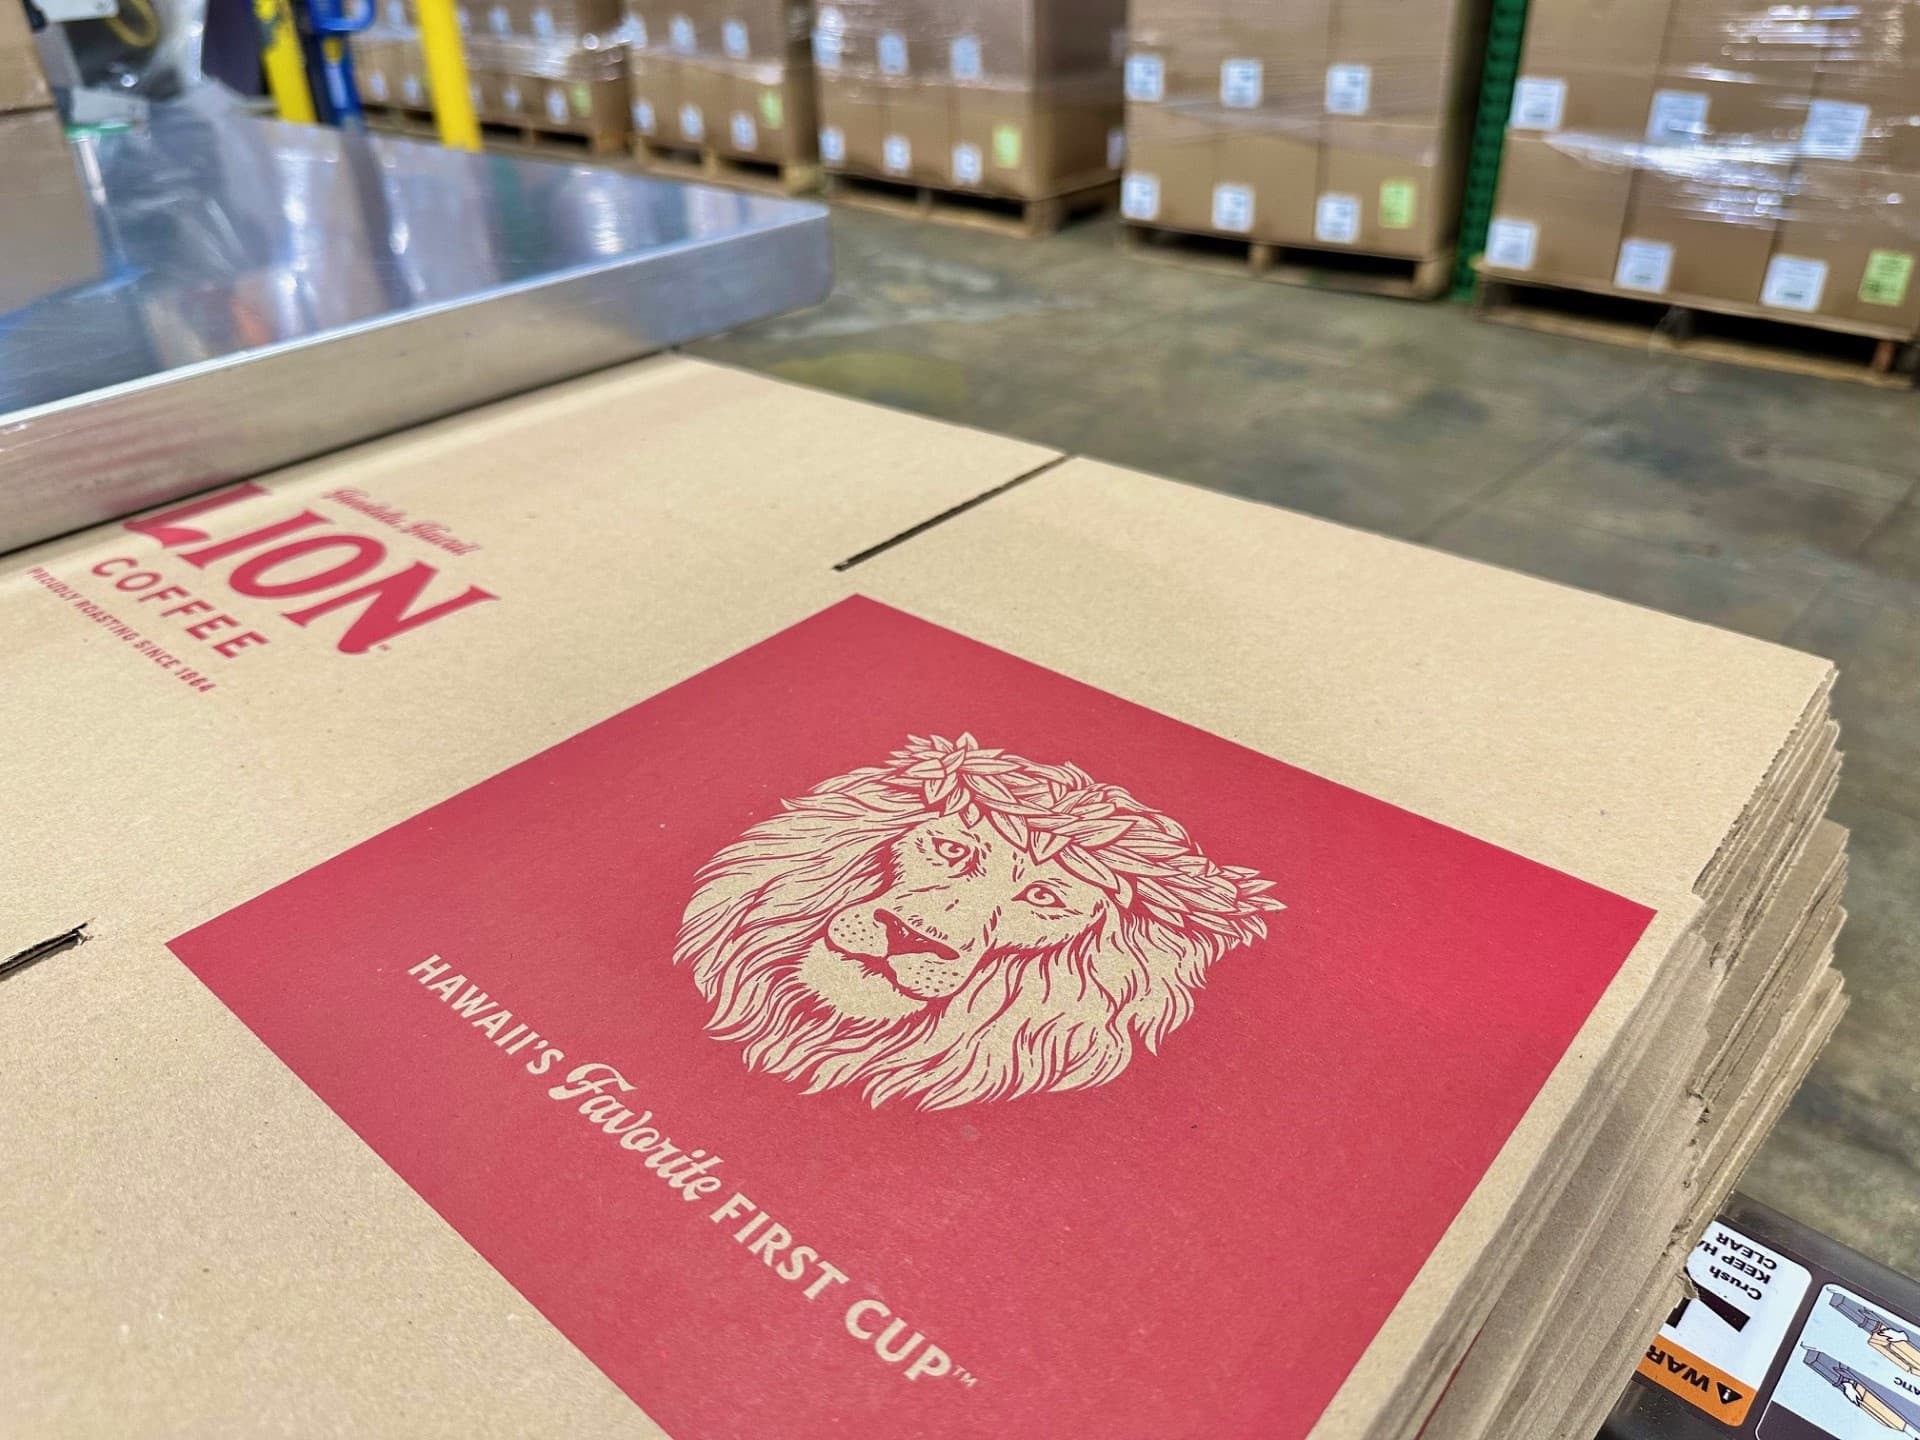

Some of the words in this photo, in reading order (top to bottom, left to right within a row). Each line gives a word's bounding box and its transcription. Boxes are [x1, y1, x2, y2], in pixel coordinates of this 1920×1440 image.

[26, 567, 82, 601] PROUDLY
[73, 600, 140, 642] ROASTING
[133, 639, 182, 669] SINCE
[91, 556, 270, 659] COFFEE
[121, 480, 501, 655] LION
[408, 953, 566, 1076] HAWAII'S
[548, 1062, 726, 1201] Favorite
[709, 1192, 851, 1300] FIRST
[1709, 1265, 1762, 1301] Crush
[1715, 1231, 1778, 1271] CLEAR
[1721, 1255, 1772, 1285] KEEP
